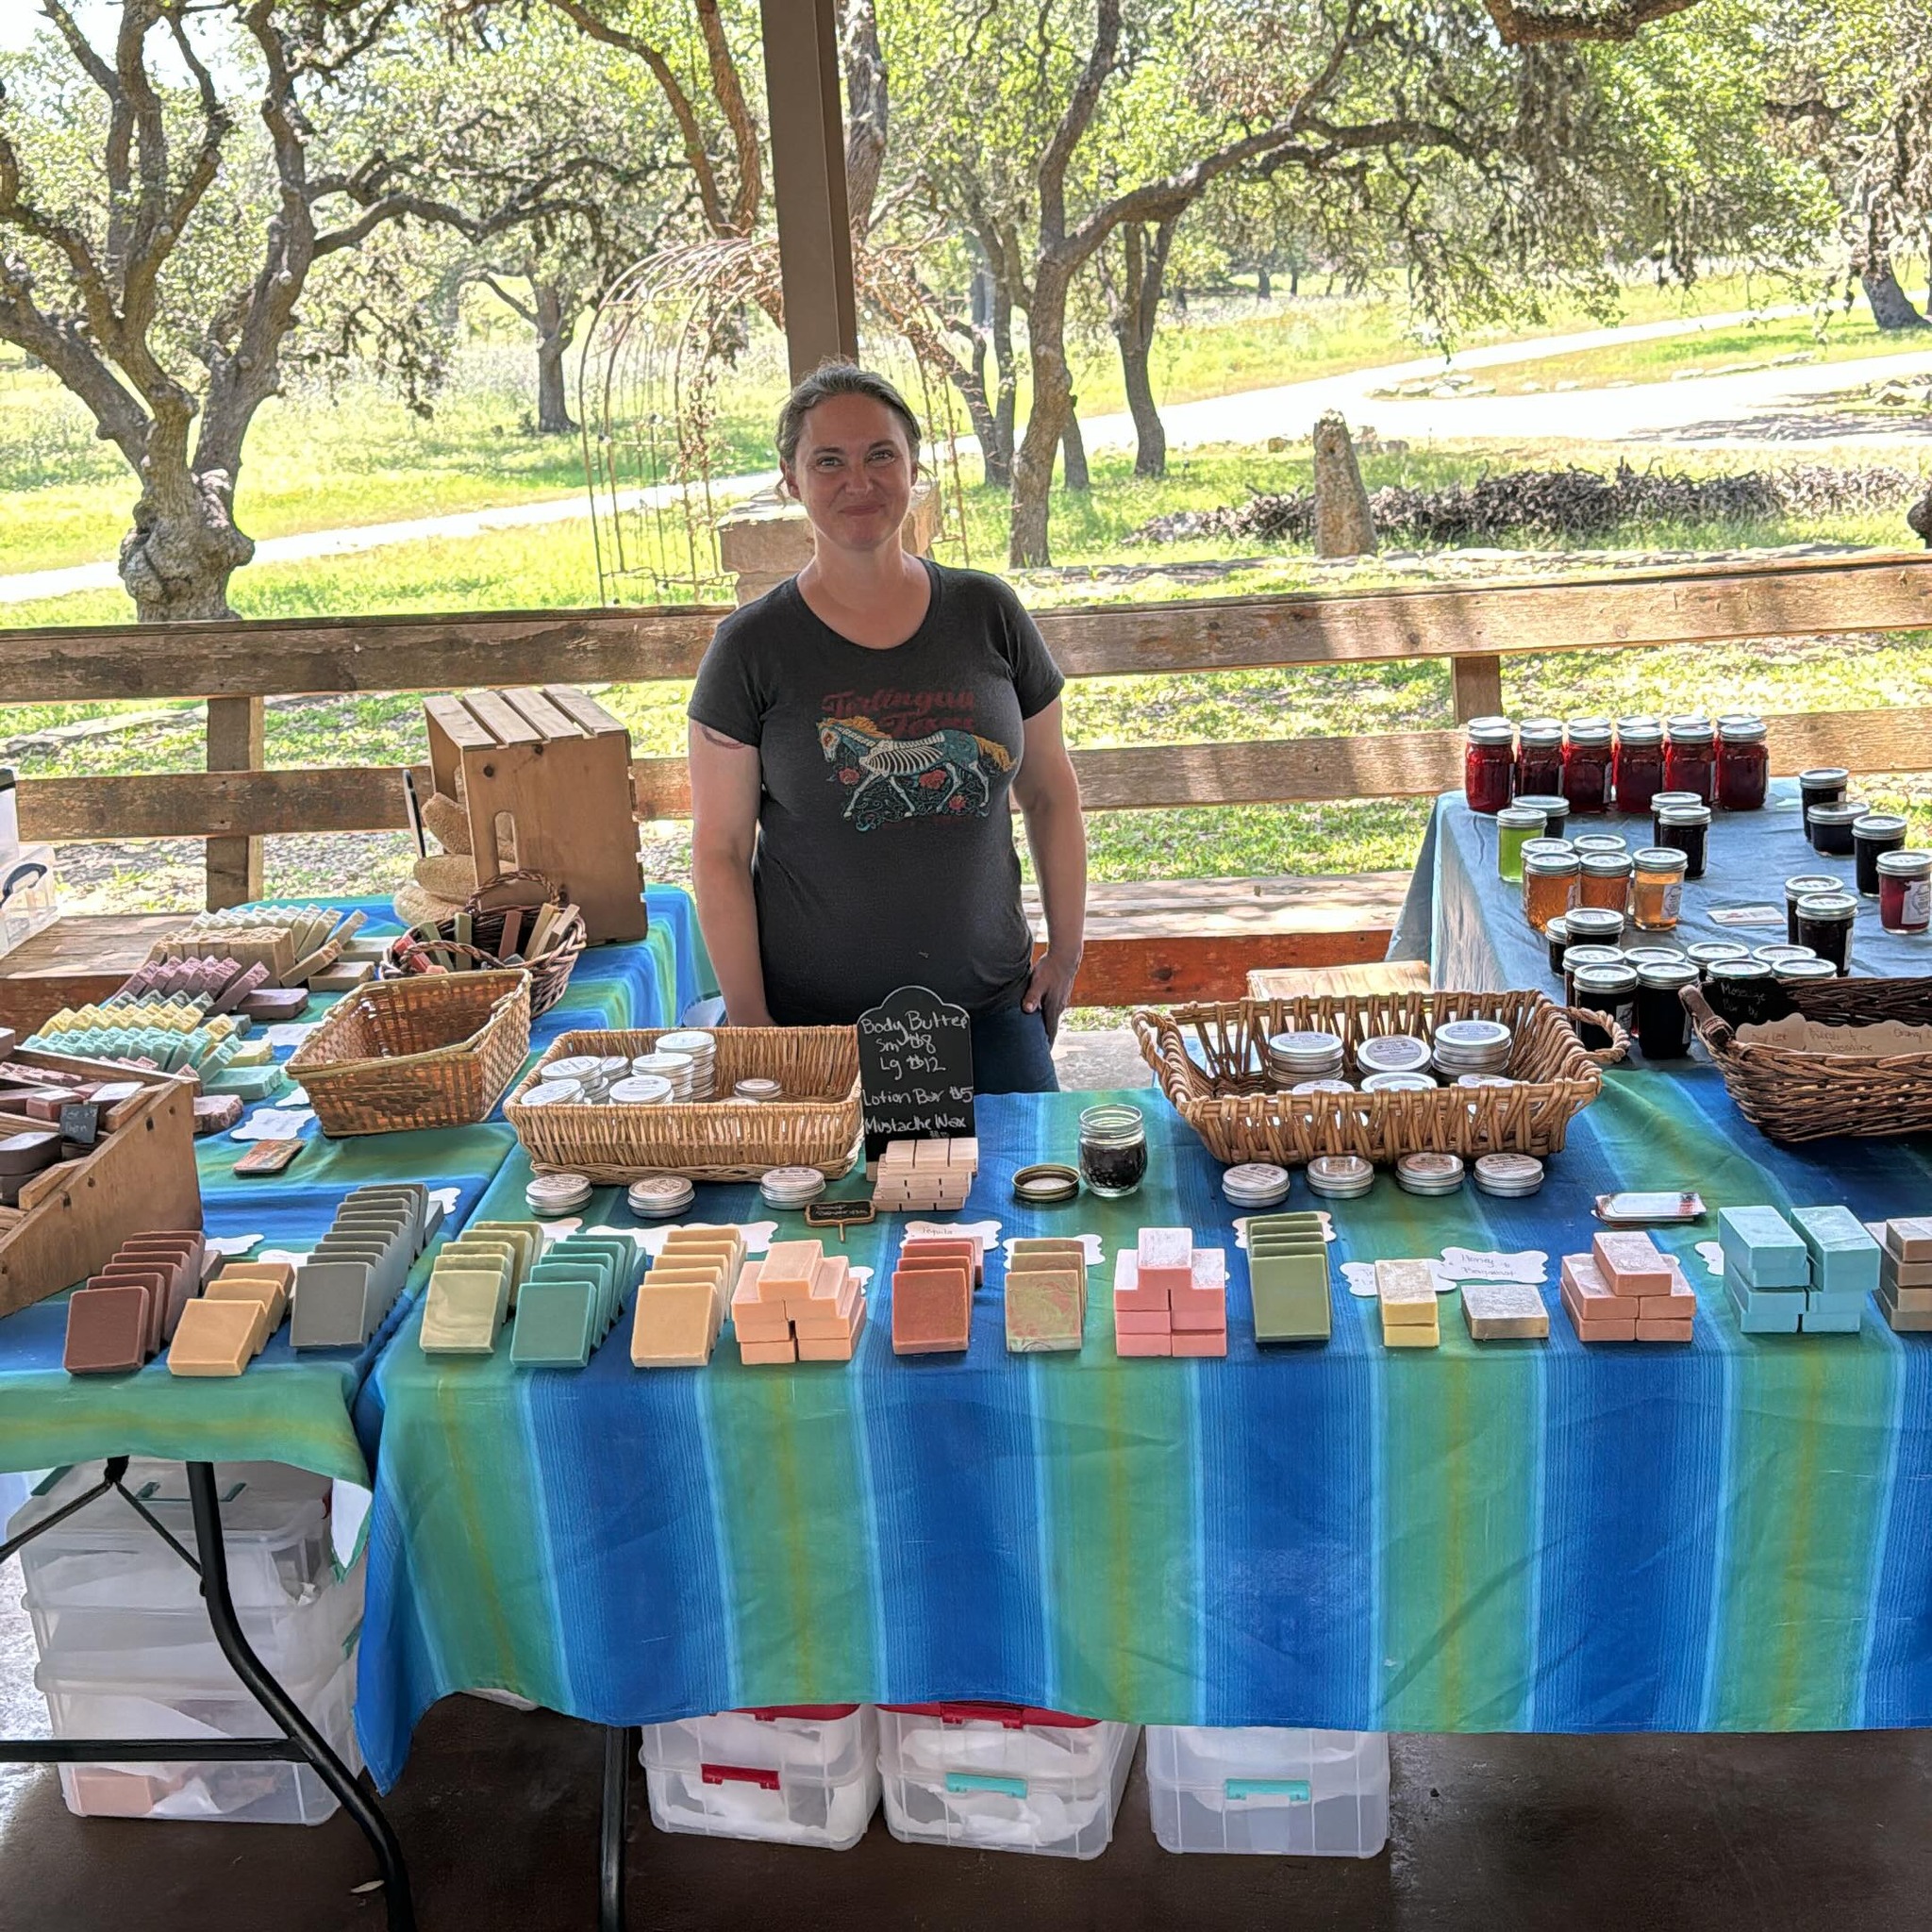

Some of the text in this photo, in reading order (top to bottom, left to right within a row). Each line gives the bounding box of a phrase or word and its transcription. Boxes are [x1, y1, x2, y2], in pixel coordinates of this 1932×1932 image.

[860, 1010, 969, 1043] Body Butter
[880, 1054, 946, 1080] Lg $12
[862, 1086, 974, 1107] Lotion Bar $5
[865, 1115, 933, 1135] Mustache
[934, 1113, 967, 1129] Wax
